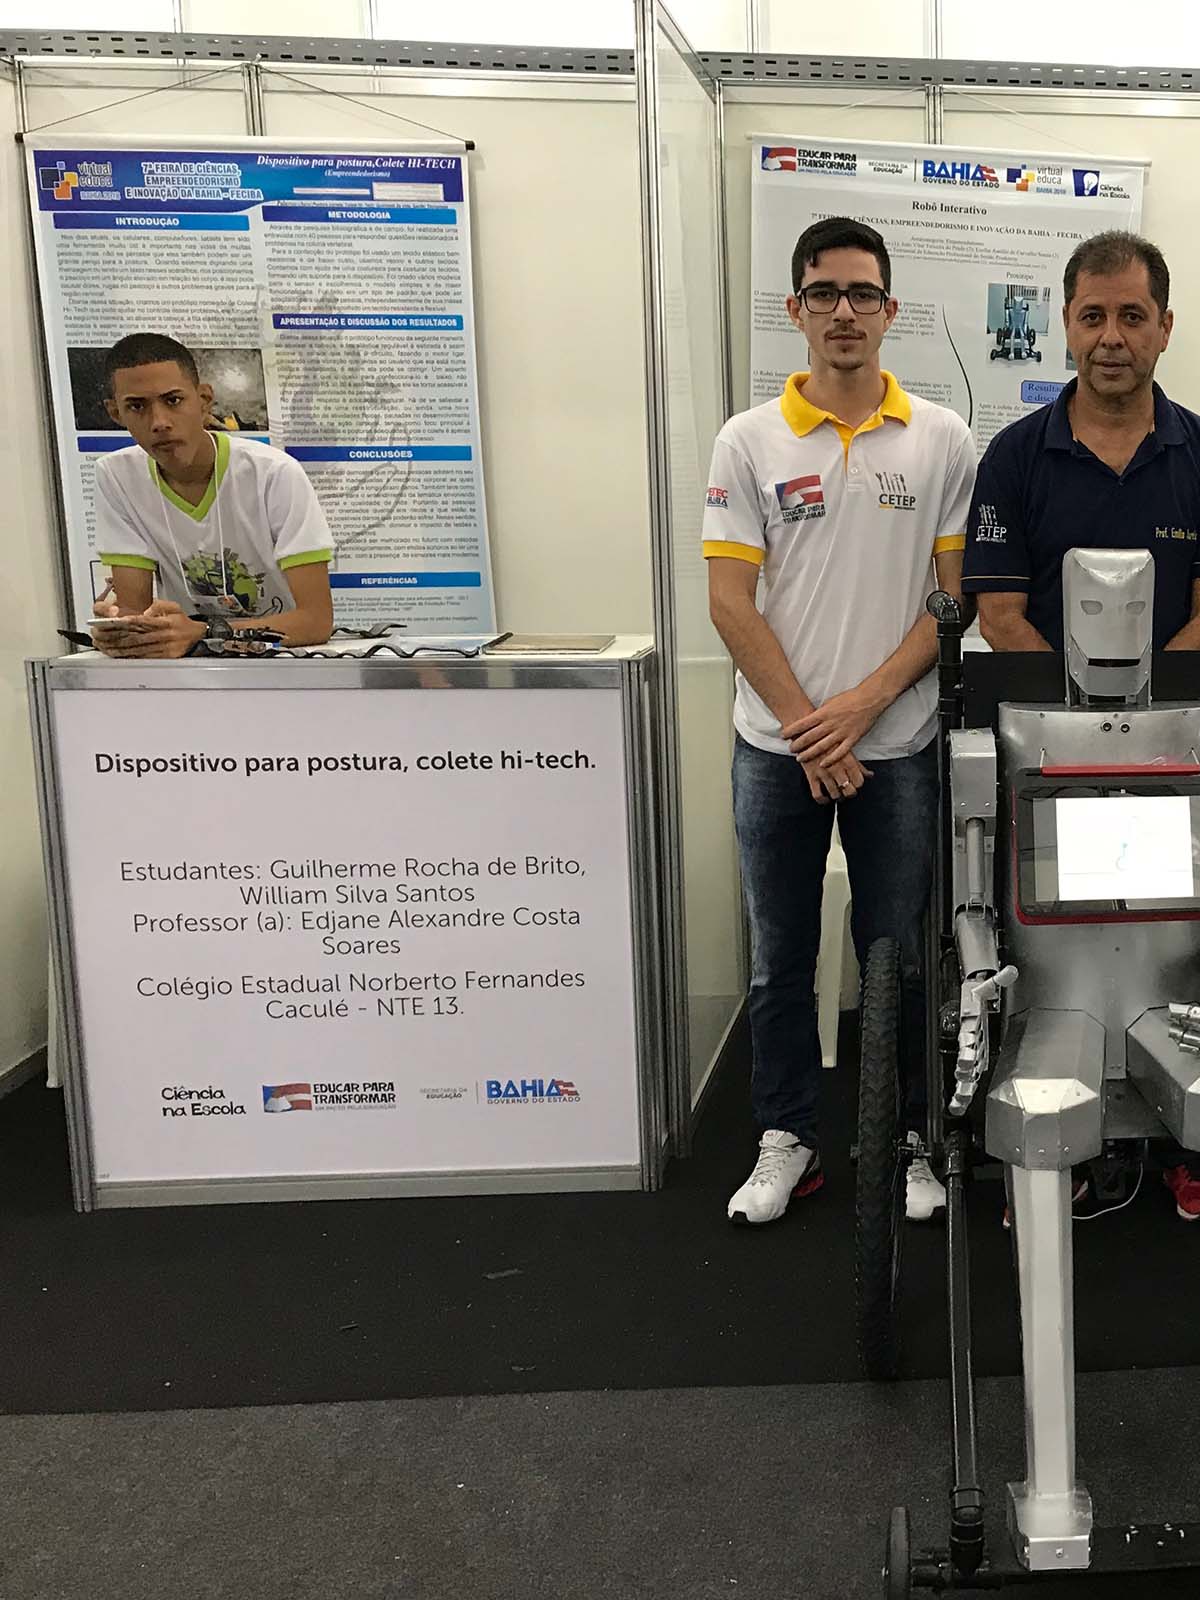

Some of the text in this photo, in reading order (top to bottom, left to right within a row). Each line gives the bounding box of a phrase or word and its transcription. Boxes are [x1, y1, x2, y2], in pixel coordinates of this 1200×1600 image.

[257, 155, 309, 168] Dispositivo
[311, 158, 335, 169] para
[407, 158, 456, 169] HI-TECH
[798, 149, 857, 162] EDUCAR PARA
[78, 161, 112, 175] virtual
[155, 163, 181, 174] FEIRA
[182, 163, 194, 174] DE
[196, 161, 242, 176] CIÊNCIAS,
[797, 158, 857, 171] TRANSFORMAR
[873, 166, 903, 174] EDUCAÇÃO
[923, 160, 986, 181] BAHIA
[1037, 165, 1063, 176] virtual
[79, 175, 113, 187] educa
[145, 175, 240, 186] EMPREENDEDORISMO
[922, 177, 957, 185] GOVERNO
[972, 180, 1000, 189] ESTADO
[1037, 174, 1062, 185] educa
[126, 188, 132, 198] E
[134, 187, 179, 200] INOVAÇÃO
[181, 188, 193, 199] DA
[195, 188, 221, 199] BAHIA
[230, 189, 263, 200] FECIBA
[912, 201, 987, 216] Robô Interativo
[115, 216, 180, 227] INTRODUÇÃO
[328, 211, 391, 220] METODOLOGIA
[280, 317, 457, 327] APRESENTAÇÃO E DISCUSSÃO DOS RESULTADOS
[349, 448, 413, 459] CONCLUSÕES
[879, 493, 916, 507] CETEP
[977, 525, 1007, 538] CETEP
[361, 575, 418, 586] REFERÊNCIAS
[95, 750, 596, 777] Dispositivo para postura, colete hi-tech.
[121, 856, 585, 881] Estudantes: Guilherme Rocha de Brito,
[239, 883, 475, 905] William Silva Santos
[133, 907, 580, 934] Professor (a): Edjane Alexandre Costa
[322, 936, 401, 955] Soares
[137, 969, 585, 1000] Colégio Estadual Norberto Fernandes
[266, 999, 349, 1019] Caculé
[377, 997, 425, 1016] NTE
[433, 996, 464, 1015] 13.
[161, 1085, 225, 1101] Ciência
[313, 1081, 395, 1093] EDUCAR PARA
[486, 1079, 561, 1098] BAHIA
[313, 1092, 396, 1104] TRANSFORMAR
[487, 1097, 529, 1105] GOVERNO
[162, 1102, 246, 1117] na Escola
